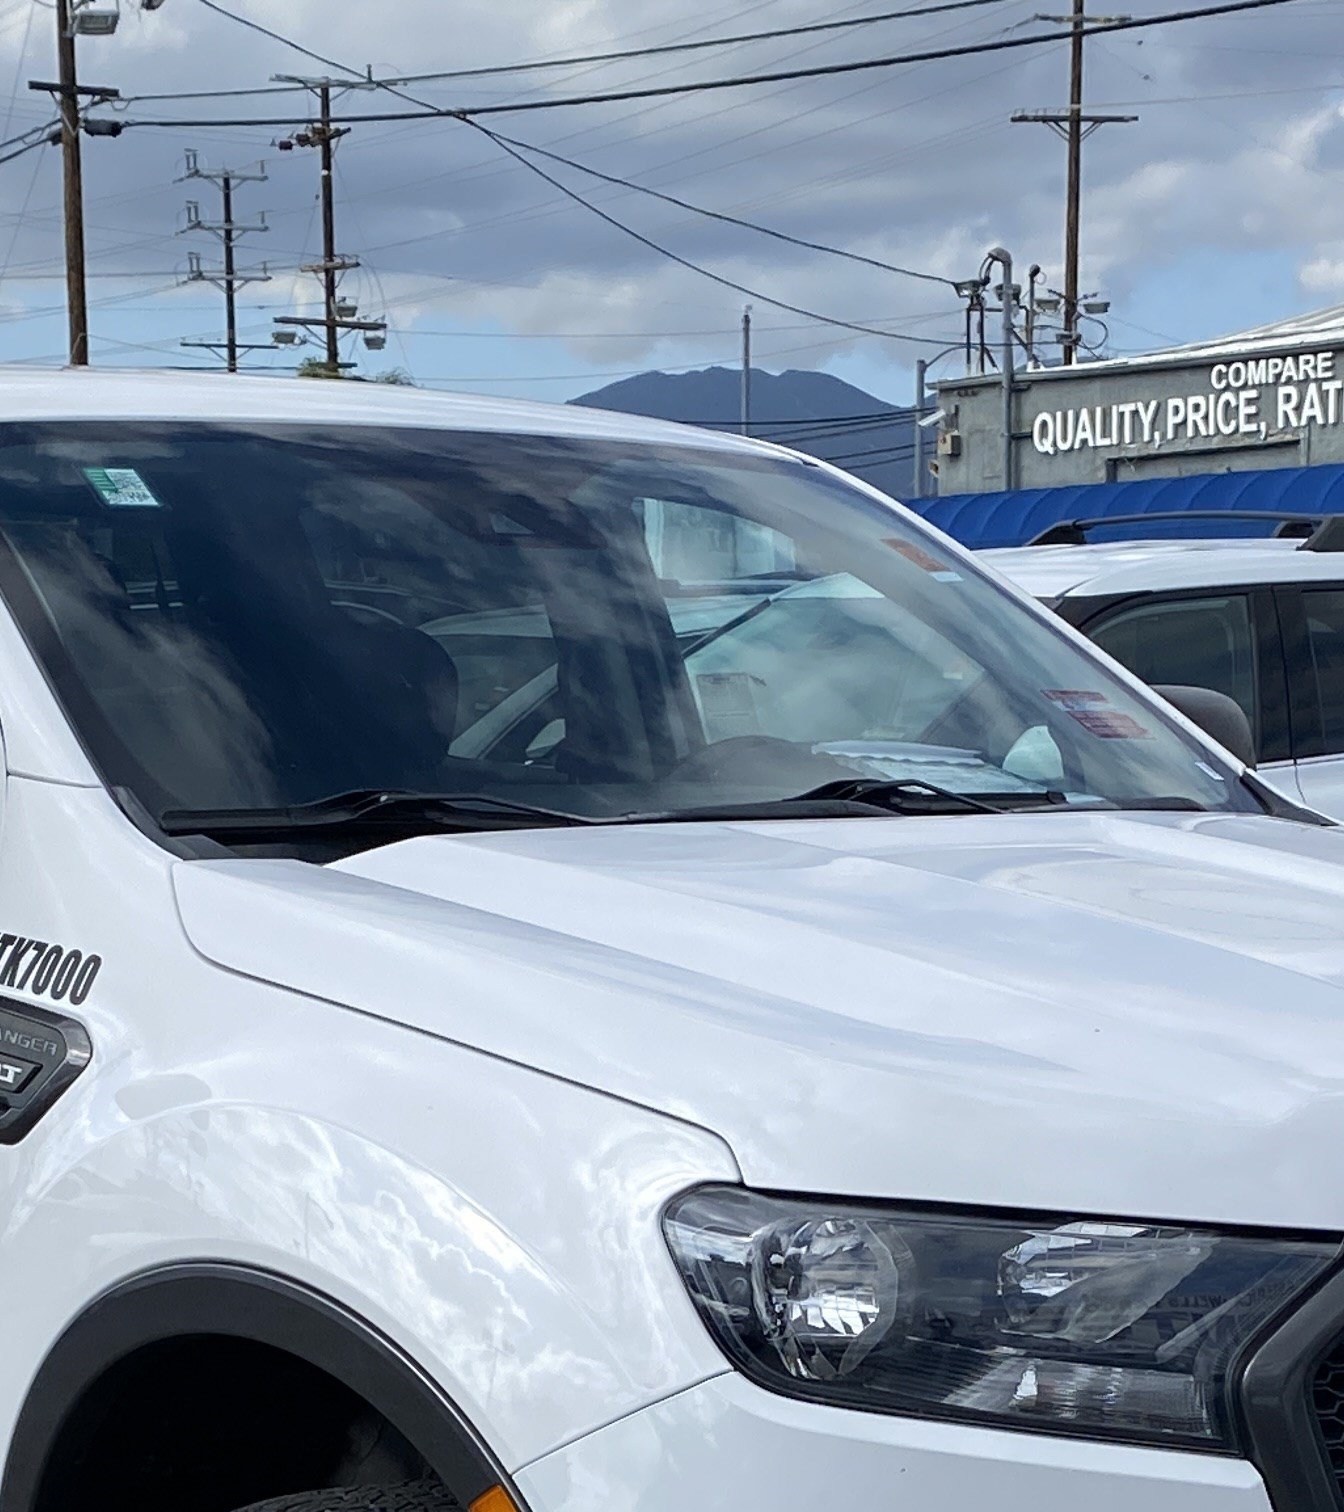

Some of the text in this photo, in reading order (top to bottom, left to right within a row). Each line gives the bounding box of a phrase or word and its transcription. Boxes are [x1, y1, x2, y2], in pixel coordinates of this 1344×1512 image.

[1210, 352, 1334, 389] COMPARE
[1032, 400, 1161, 455] QUALITY,
[1166, 389, 1267, 440] PRICE,
